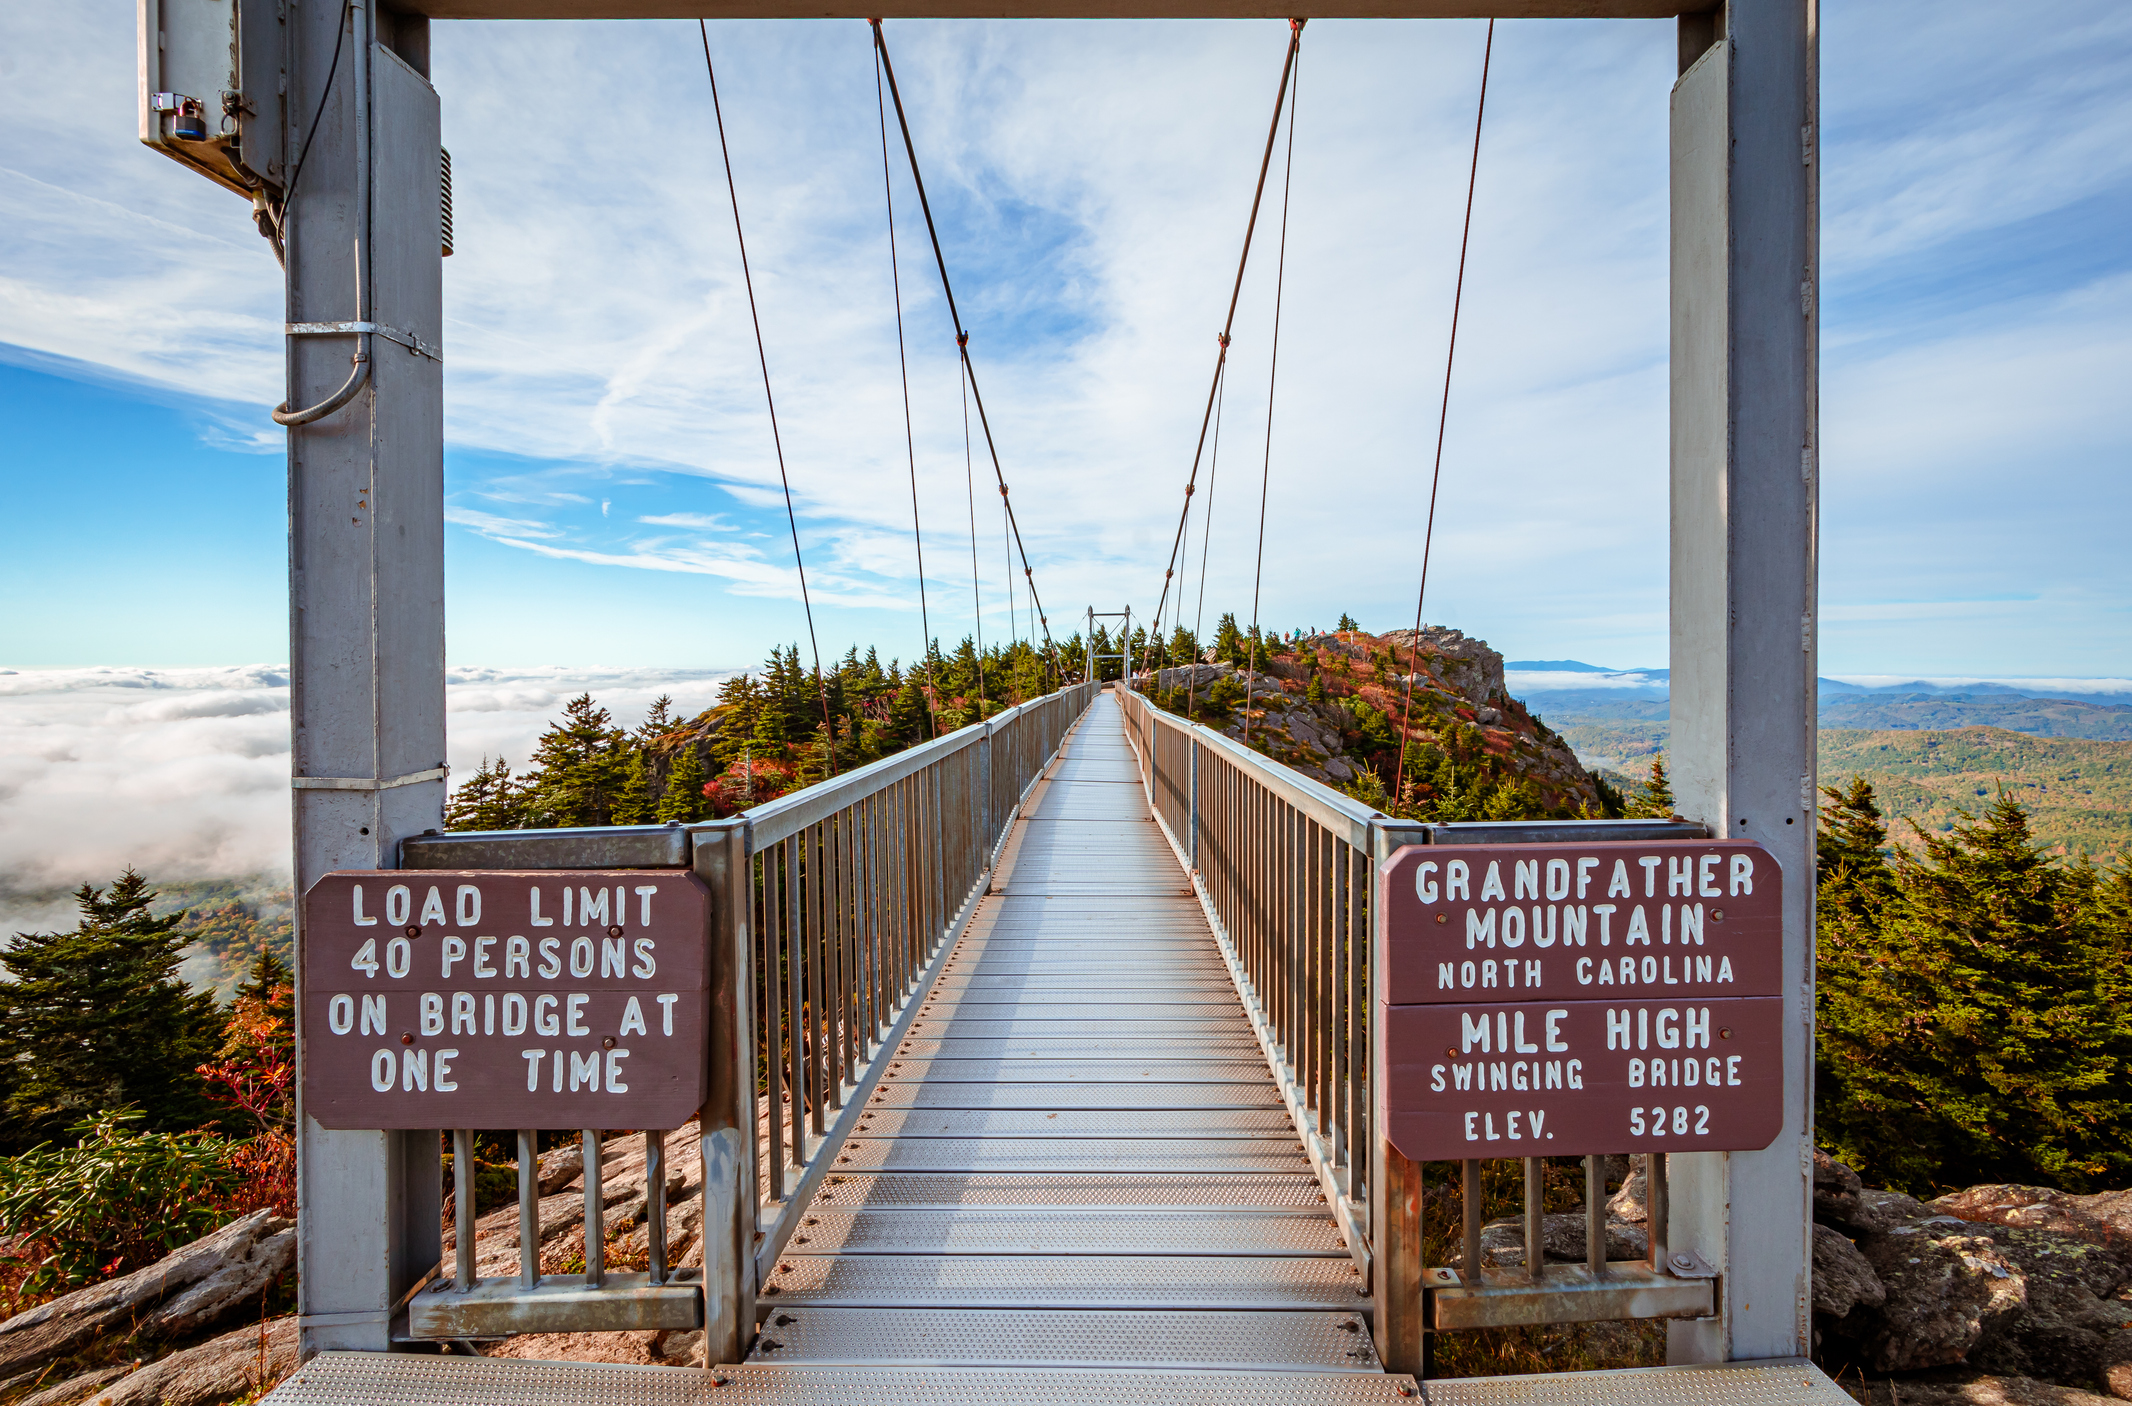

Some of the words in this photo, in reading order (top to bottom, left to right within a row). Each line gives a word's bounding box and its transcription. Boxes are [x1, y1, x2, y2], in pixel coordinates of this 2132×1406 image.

[1415, 853, 1754, 905] GRANDFATHER
[353, 884, 482, 927] LOAD
[530, 885, 658, 927] LIMIT
[1465, 902, 1704, 950] MOUNTAIN
[350, 936, 411, 979] 40
[441, 935, 656, 980] PERSONS
[1438, 958, 1542, 990] NORTH
[1576, 955, 1734, 985] CAROLINA
[328, 993, 387, 1036] ON
[420, 991, 591, 1037] BRIDGE
[619, 993, 679, 1037] AT
[1461, 1009, 1569, 1054] MILE
[1606, 1007, 1710, 1051] HIGH
[371, 1048, 460, 1093] ONE
[521, 1048, 630, 1094] TIME
[1430, 1058, 1584, 1092] SWINGING
[1628, 1055, 1742, 1088] BRIDGE
[1464, 1109, 1554, 1141] ELEV.
[1629, 1104, 1710, 1136] 5282
